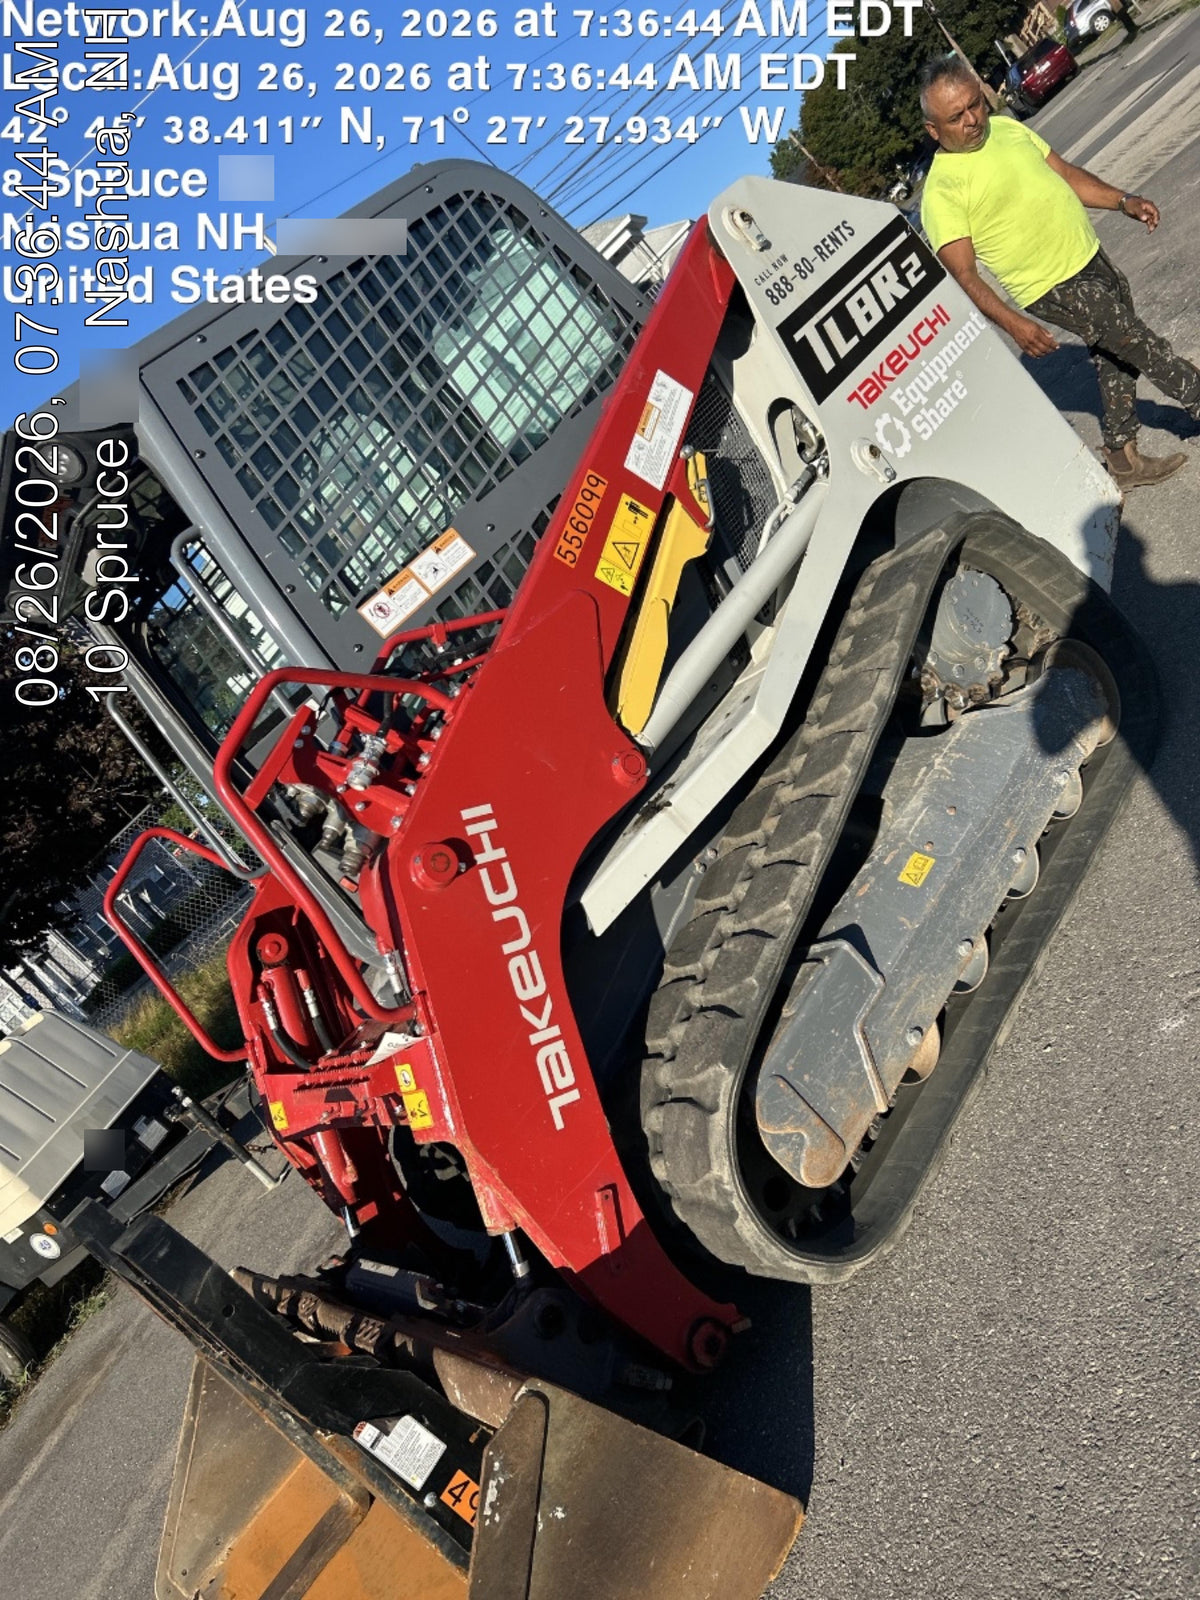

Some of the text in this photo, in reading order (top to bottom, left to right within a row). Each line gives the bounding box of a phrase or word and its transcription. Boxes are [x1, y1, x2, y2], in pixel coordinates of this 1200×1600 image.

[754, 253, 789, 287] CALL NOW
[765, 220, 856, 306] 888-80-RENTS
[889, 310, 987, 417] Equipment
[556, 474, 606, 564] 556099
